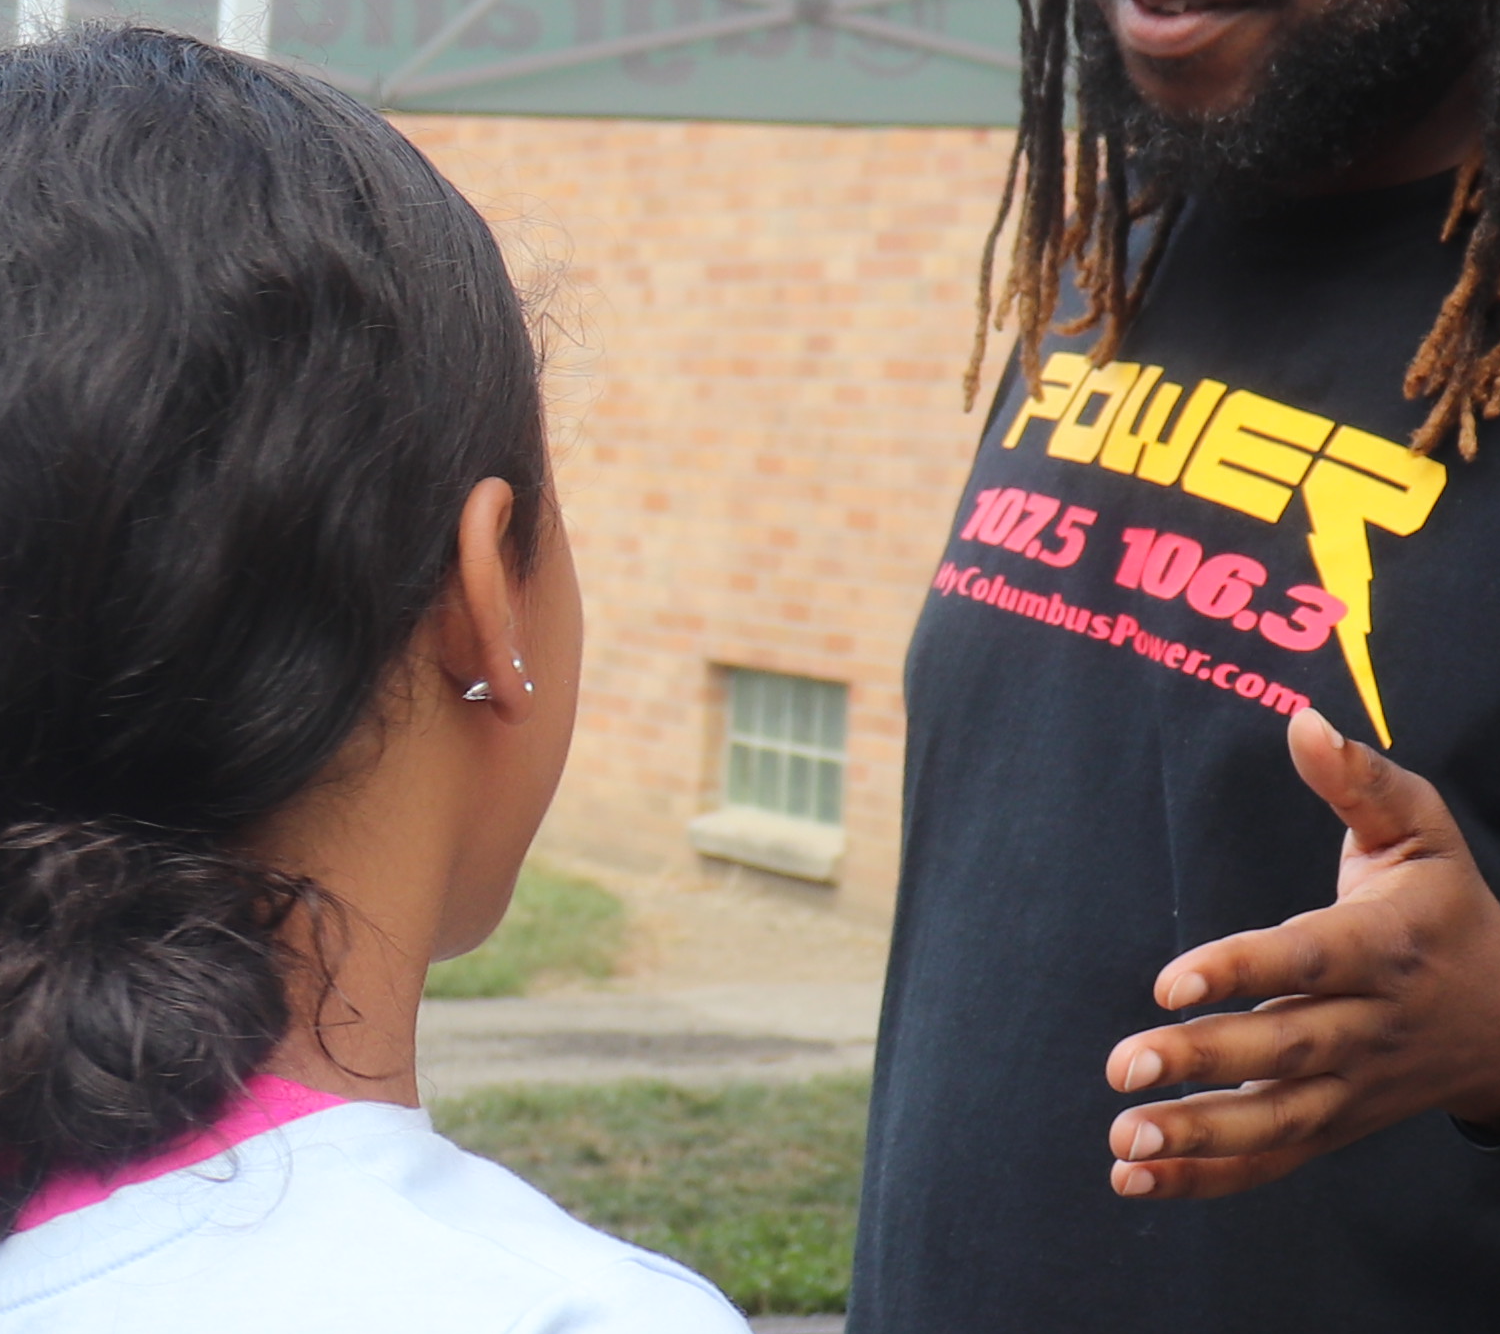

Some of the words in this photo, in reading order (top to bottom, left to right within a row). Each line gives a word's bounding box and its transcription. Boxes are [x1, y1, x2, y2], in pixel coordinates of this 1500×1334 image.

[959, 487, 1098, 569] 107.5
[1114, 527, 1347, 652] 106.3
[1001, 352, 1447, 749] POWER
[934, 561, 1313, 717] MyColumbusPower.com
